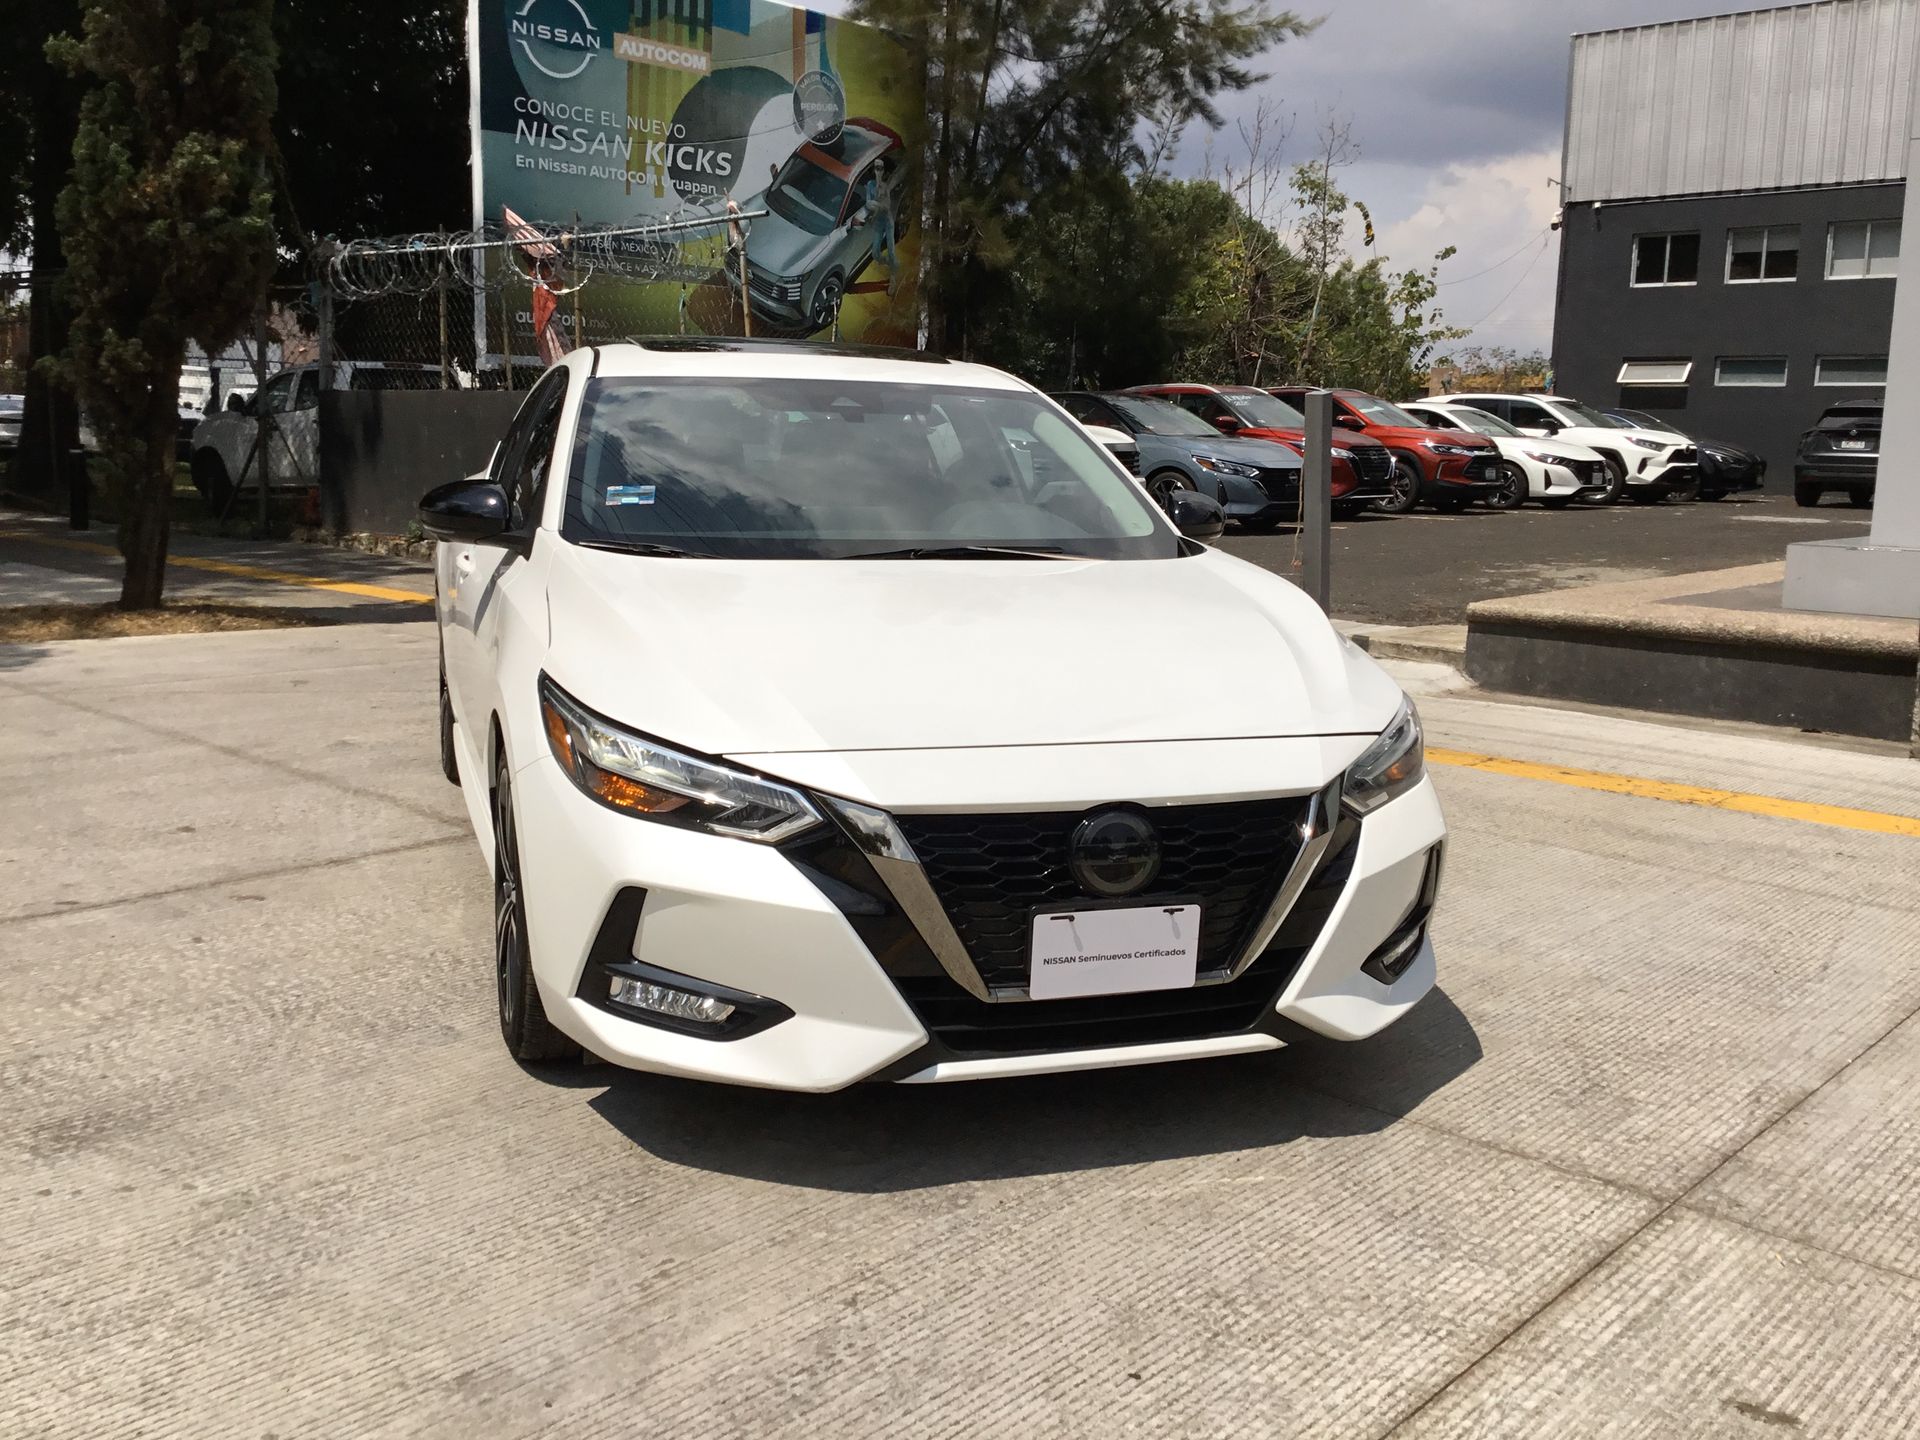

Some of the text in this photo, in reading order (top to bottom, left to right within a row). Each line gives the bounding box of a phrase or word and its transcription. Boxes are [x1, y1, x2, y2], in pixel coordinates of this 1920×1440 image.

[513, 20, 600, 49] NISSAN
[619, 40, 706, 70] AUTOCOM
[514, 97, 686, 139] CONOCE EL NUEVO
[515, 119, 732, 176] NISSAN KICKS
[516, 155, 717, 196] En Nissan AUTOCOM Uruapan
[621, 241, 658, 254] MÉXICO
[1043, 948, 1186, 966] NISSAN Seminuevos Certificados
